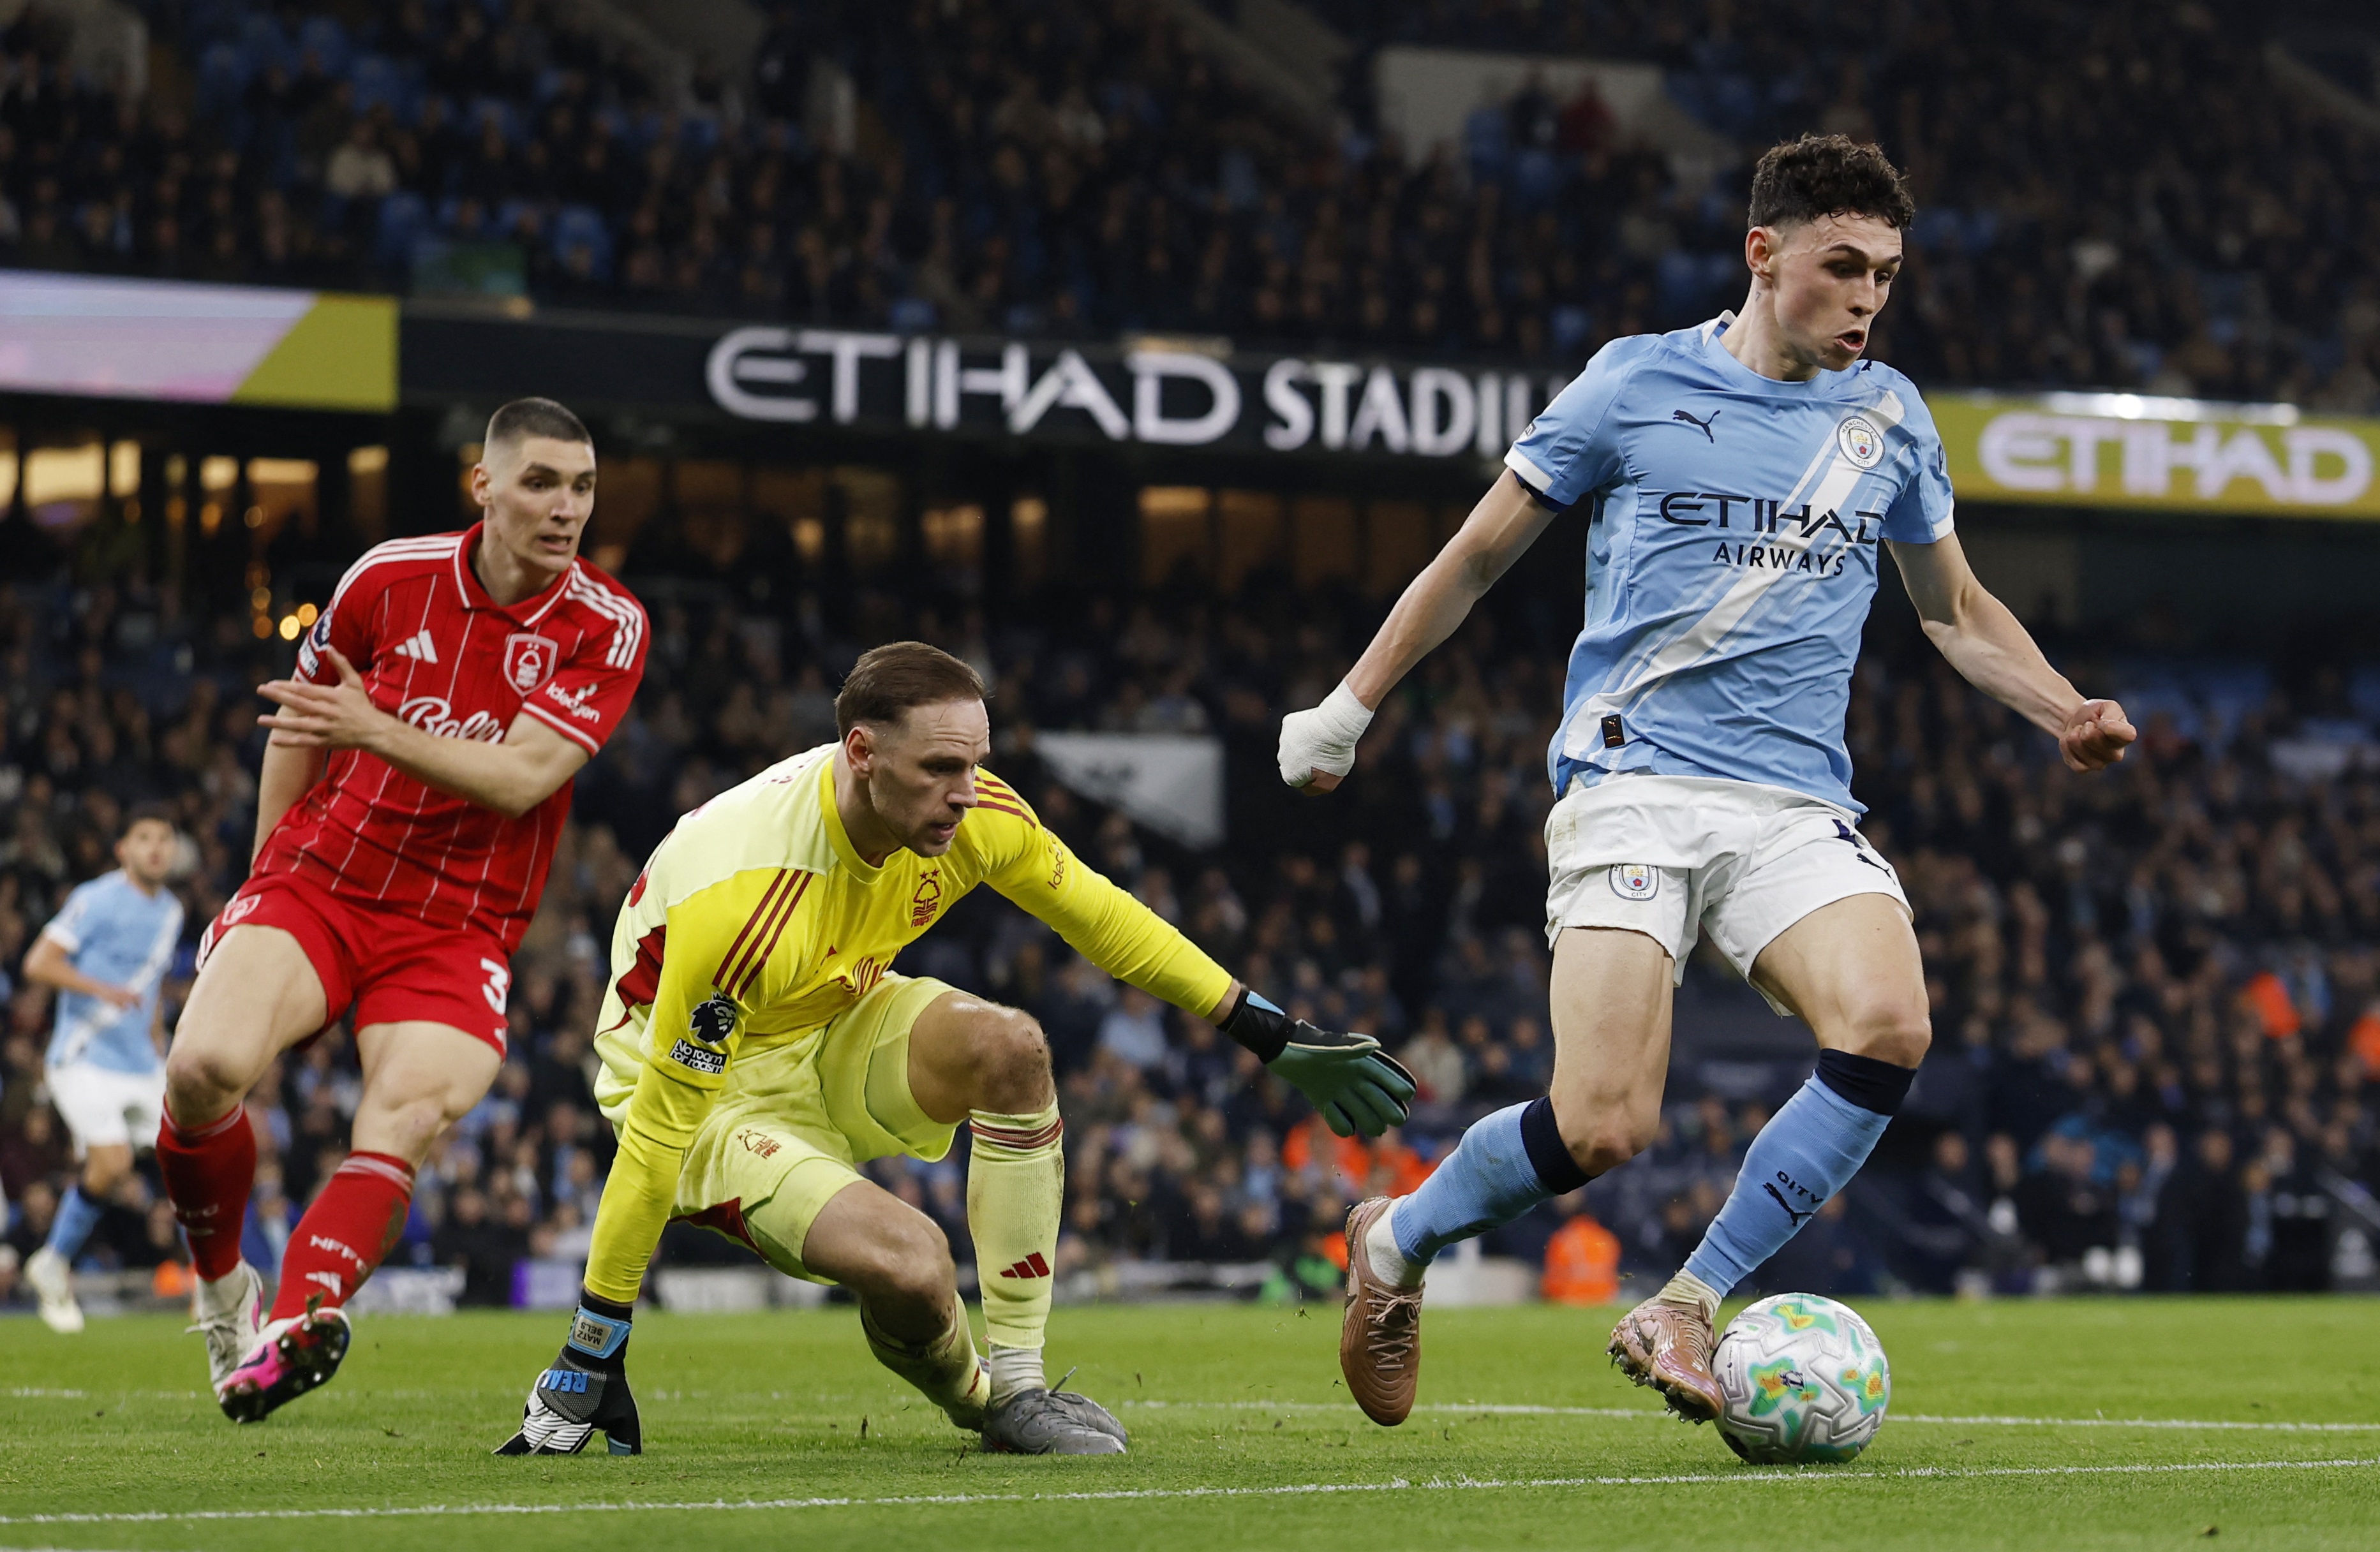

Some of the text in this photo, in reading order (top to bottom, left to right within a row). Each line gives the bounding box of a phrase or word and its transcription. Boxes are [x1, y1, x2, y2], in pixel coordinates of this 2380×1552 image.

[705, 326, 1561, 457] ETIHAD STADI
[1841, 420, 1878, 439] MANCHESTER
[1979, 411, 2372, 506] ETIHAD
[1660, 492, 1885, 543] ETIHAD
[1713, 542, 1845, 576] AIRWAYS
[669, 1047, 724, 1074] for racism
[676, 1038, 723, 1065] No room
[577, 1329, 602, 1346] MATZ
[580, 1321, 604, 1336] SELS
[540, 1370, 589, 1394] REAL
